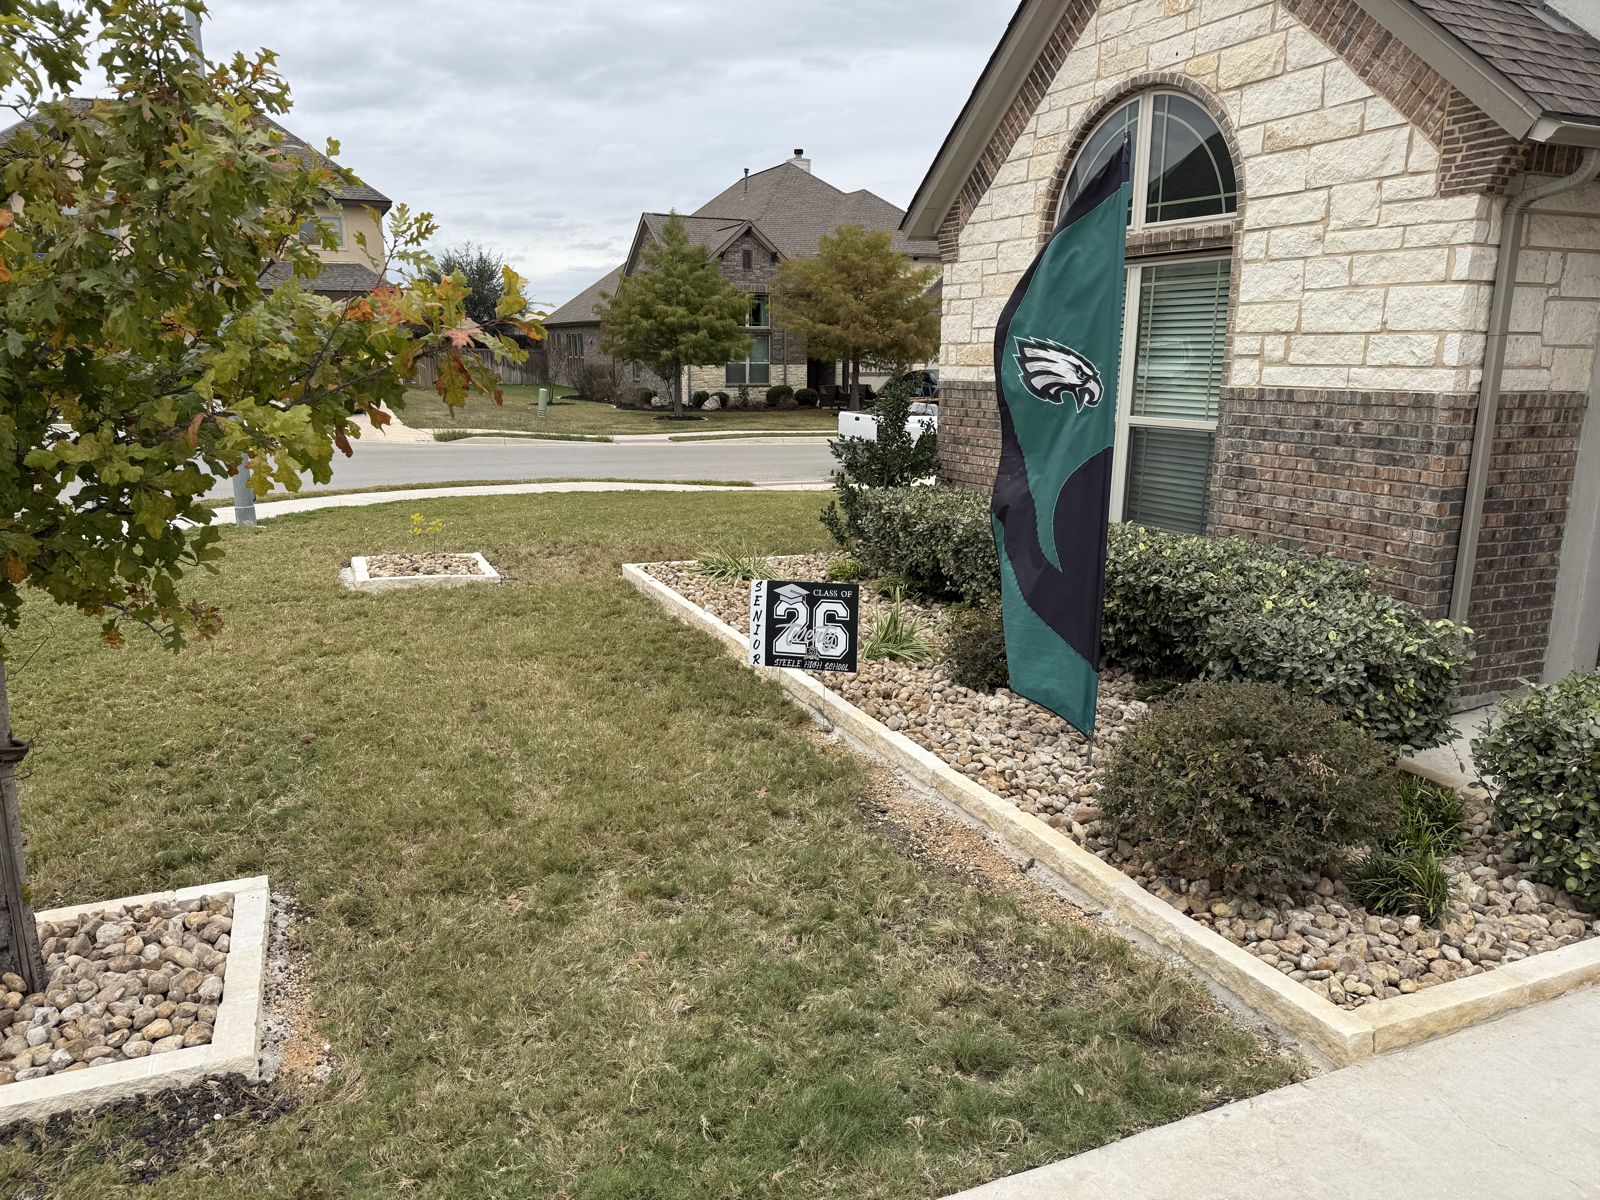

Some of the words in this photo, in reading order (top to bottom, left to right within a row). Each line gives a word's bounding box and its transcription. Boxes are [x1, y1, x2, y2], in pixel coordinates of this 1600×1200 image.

[813, 589, 838, 598] CLASS
[841, 590, 853, 598] OF
[752, 581, 763, 665] SENIOR
[773, 599, 850, 659] 26
[774, 658, 802, 667] STEELE
[804, 660, 822, 670] HIGH
[824, 662, 849, 671] SCHOOL
